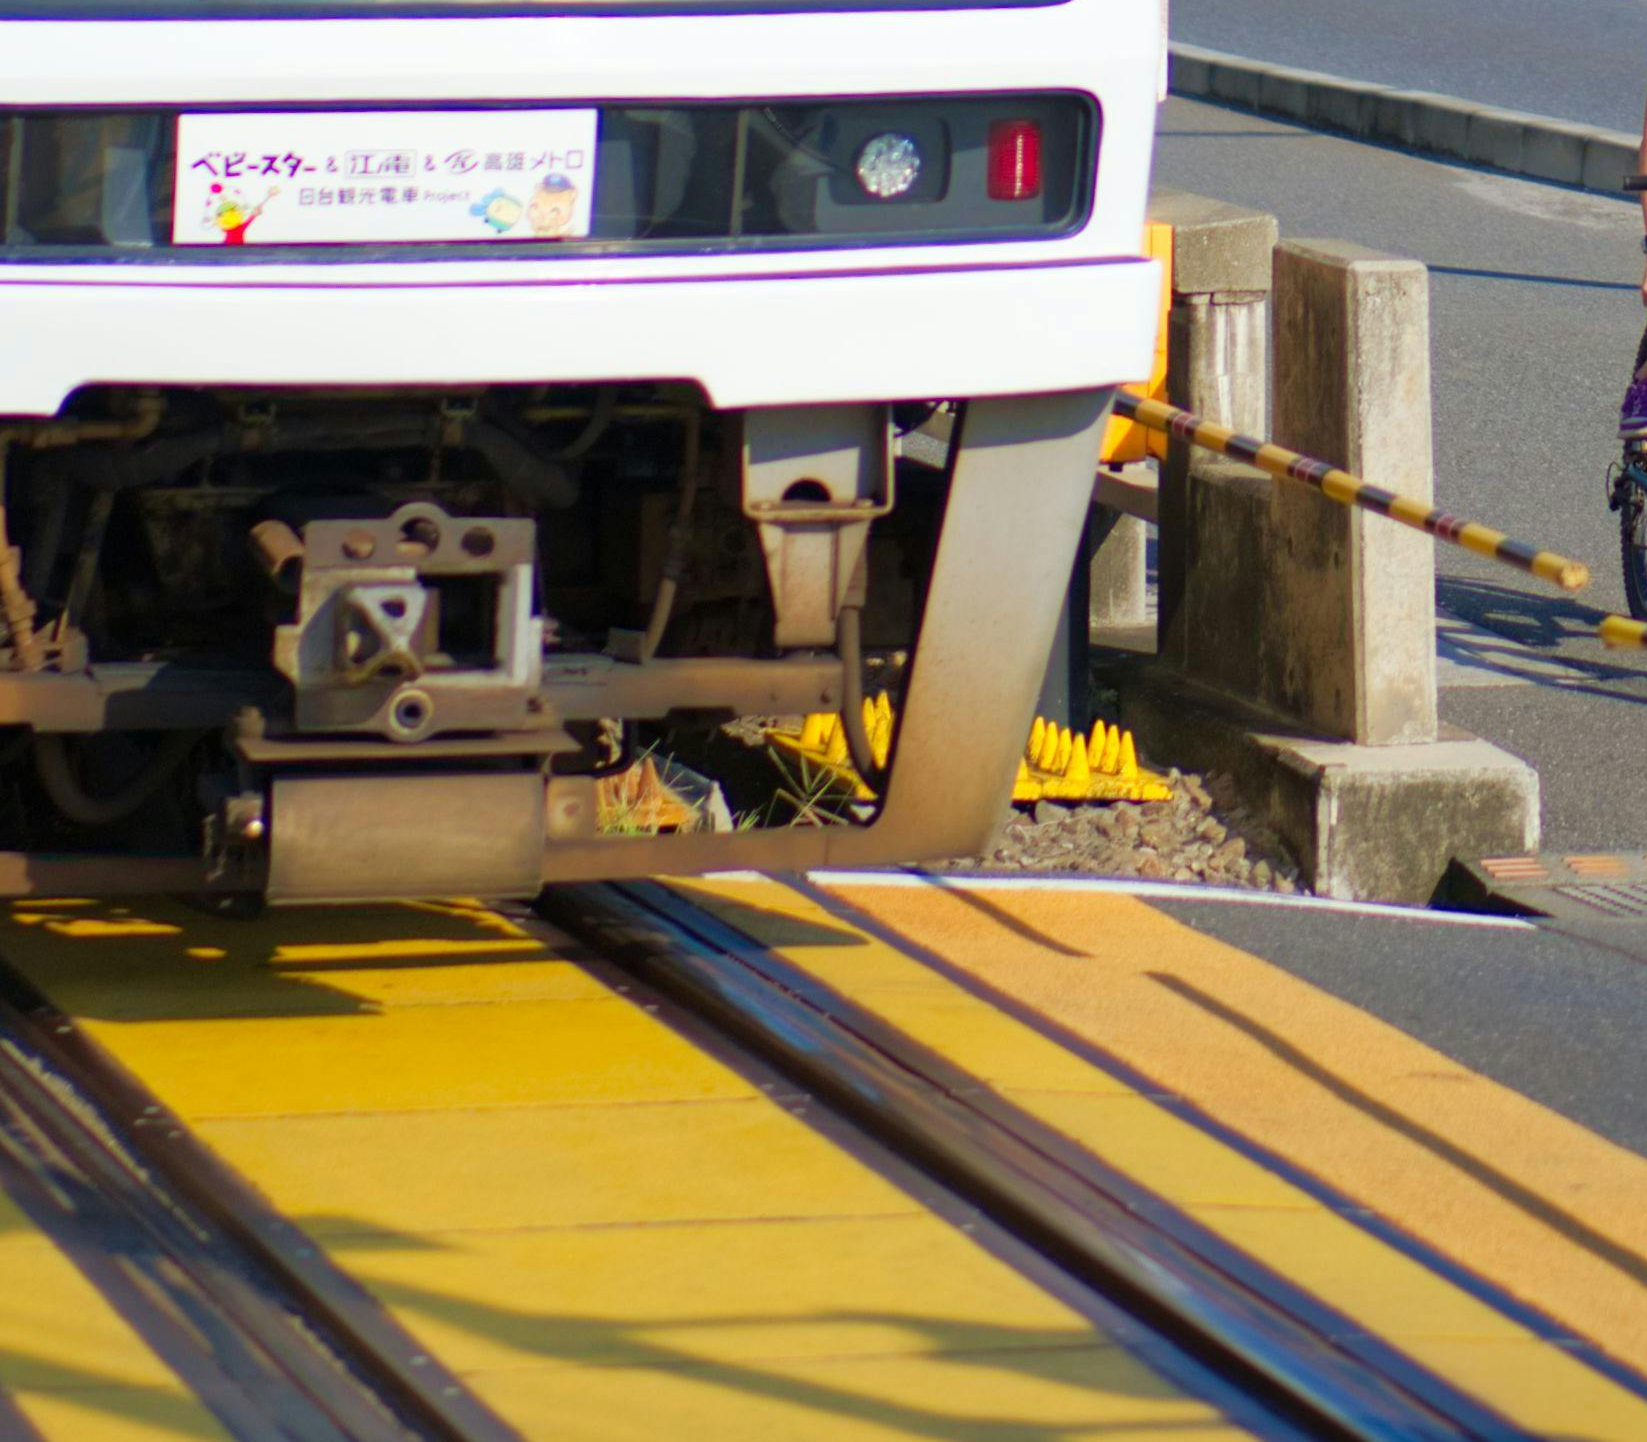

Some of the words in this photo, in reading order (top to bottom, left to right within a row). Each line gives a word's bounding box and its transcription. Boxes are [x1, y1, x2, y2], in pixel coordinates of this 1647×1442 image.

[191, 151, 316, 177] ベビースター
[299, 186, 418, 205] 日台観光電車
[423, 190, 471, 203] Project
